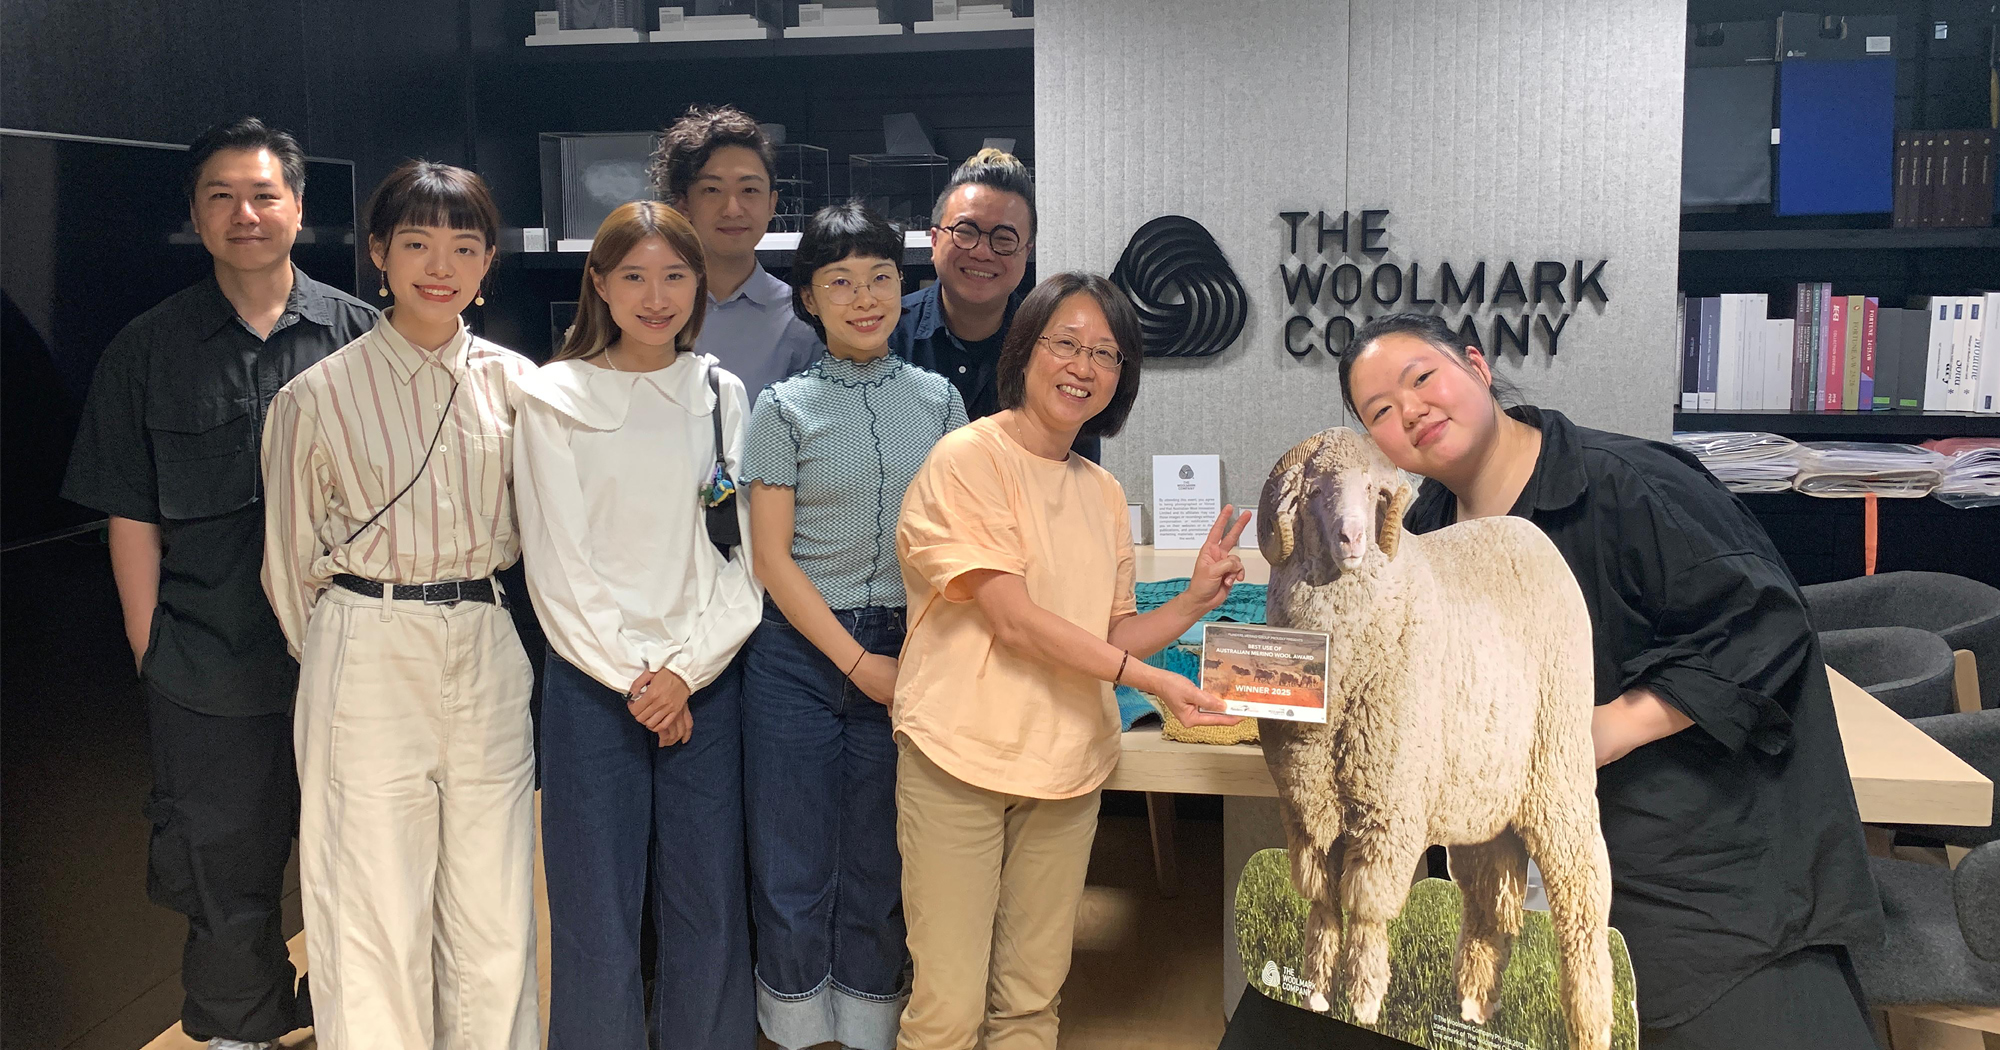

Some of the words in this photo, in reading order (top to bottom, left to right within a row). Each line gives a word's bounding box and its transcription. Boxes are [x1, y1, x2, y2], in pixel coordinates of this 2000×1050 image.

[1279, 210, 1390, 255] THE
[1279, 259, 1609, 306] WOOLMARK
[1867, 309, 1875, 336] FORTUNE
[1284, 312, 1570, 357] COANY
[1850, 321, 1859, 355] FORTUNE
[1251, 650, 1273, 658] MERINO
[1235, 684, 1270, 694] WINNER
[1271, 688, 1291, 696] 2025
[1282, 974, 1317, 991] WOOLMARK
[1283, 966, 1295, 977] THE
[1282, 982, 1312, 998] COMPANY
